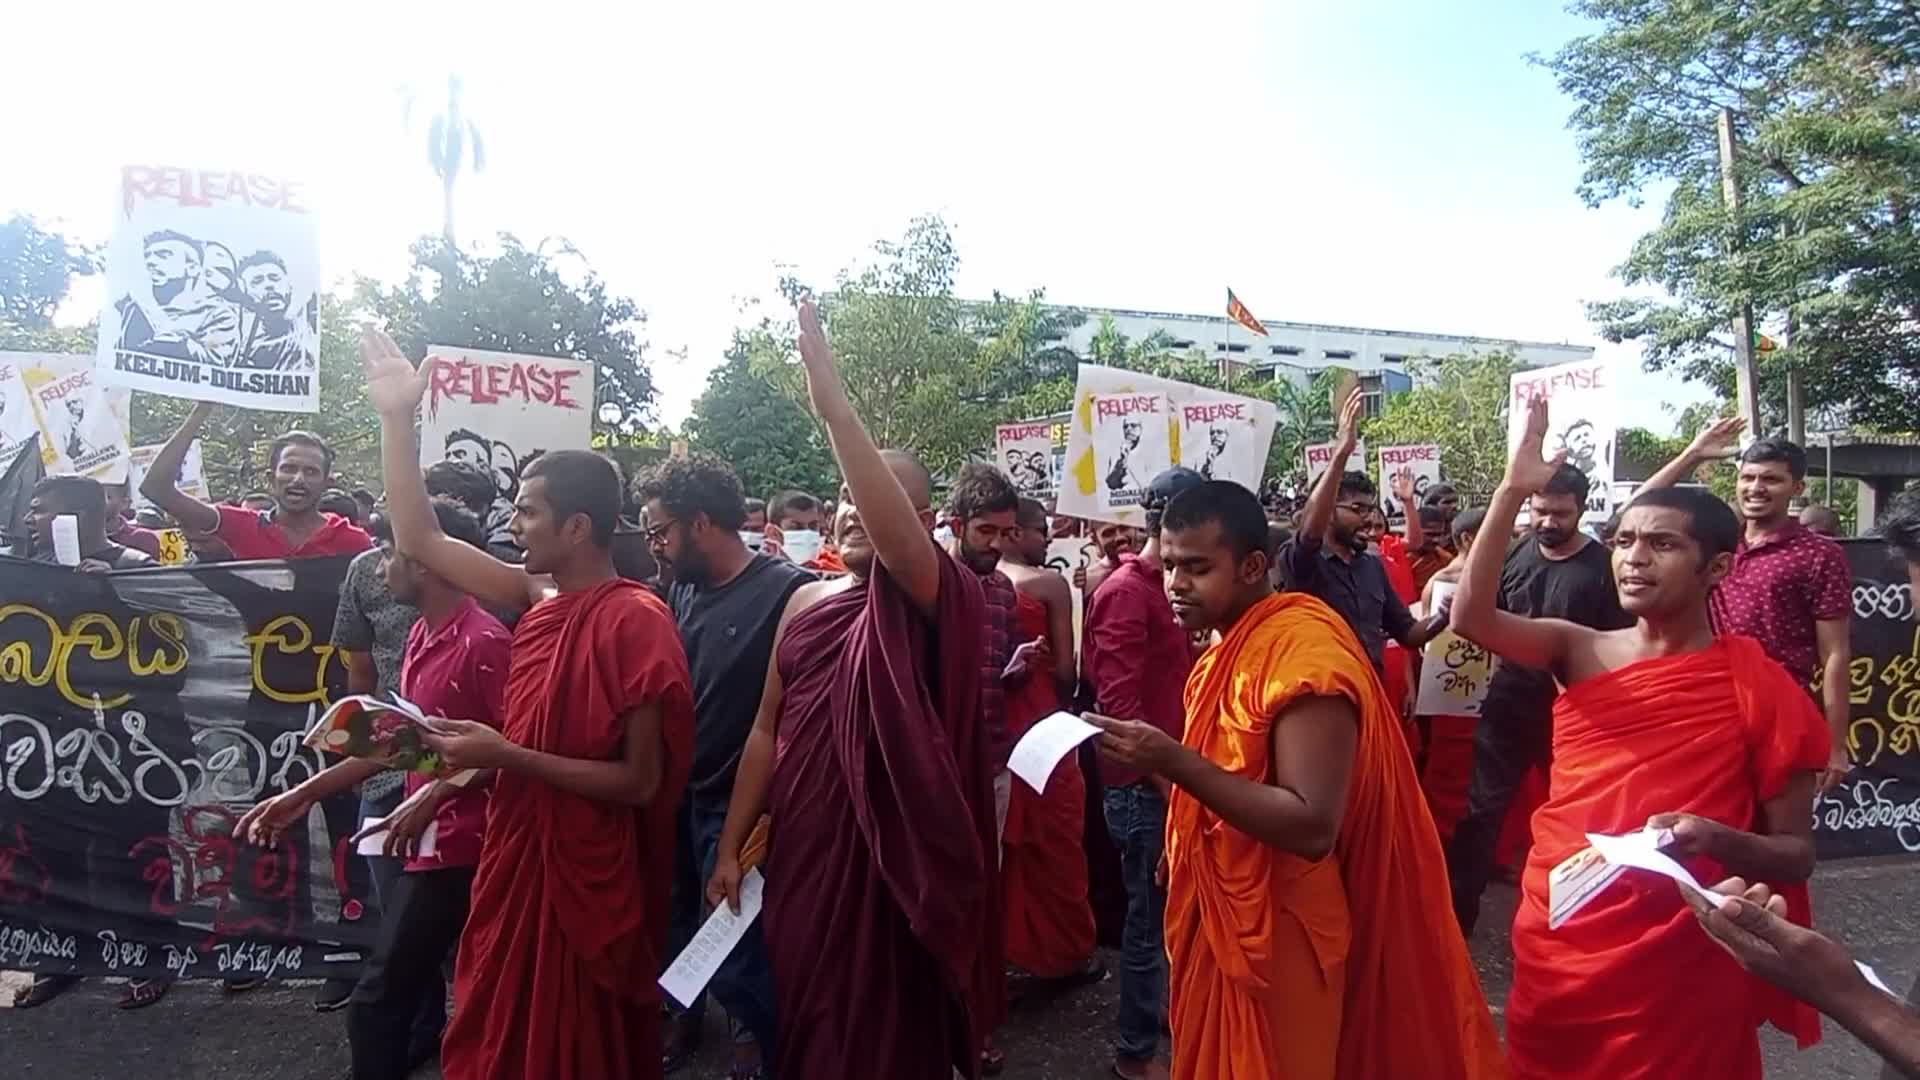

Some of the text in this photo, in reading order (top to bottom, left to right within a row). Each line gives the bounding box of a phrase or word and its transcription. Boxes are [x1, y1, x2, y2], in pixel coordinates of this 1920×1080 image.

[121, 165, 310, 218] RELEASE
[39, 370, 92, 409] RELEASE
[114, 351, 311, 397] KELUM-DILSHAN
[430, 357, 584, 424] RELEASE
[1514, 365, 1608, 411] RELEASE
[1097, 396, 1161, 424] RELEASE
[1184, 404, 1246, 431] RELEASE
[998, 425, 1049, 447] RELEASE
[1308, 441, 1361, 469] RELE
[1382, 447, 1435, 471] RELEASE
[0, 692, 326, 807] වස්ථාවක්
